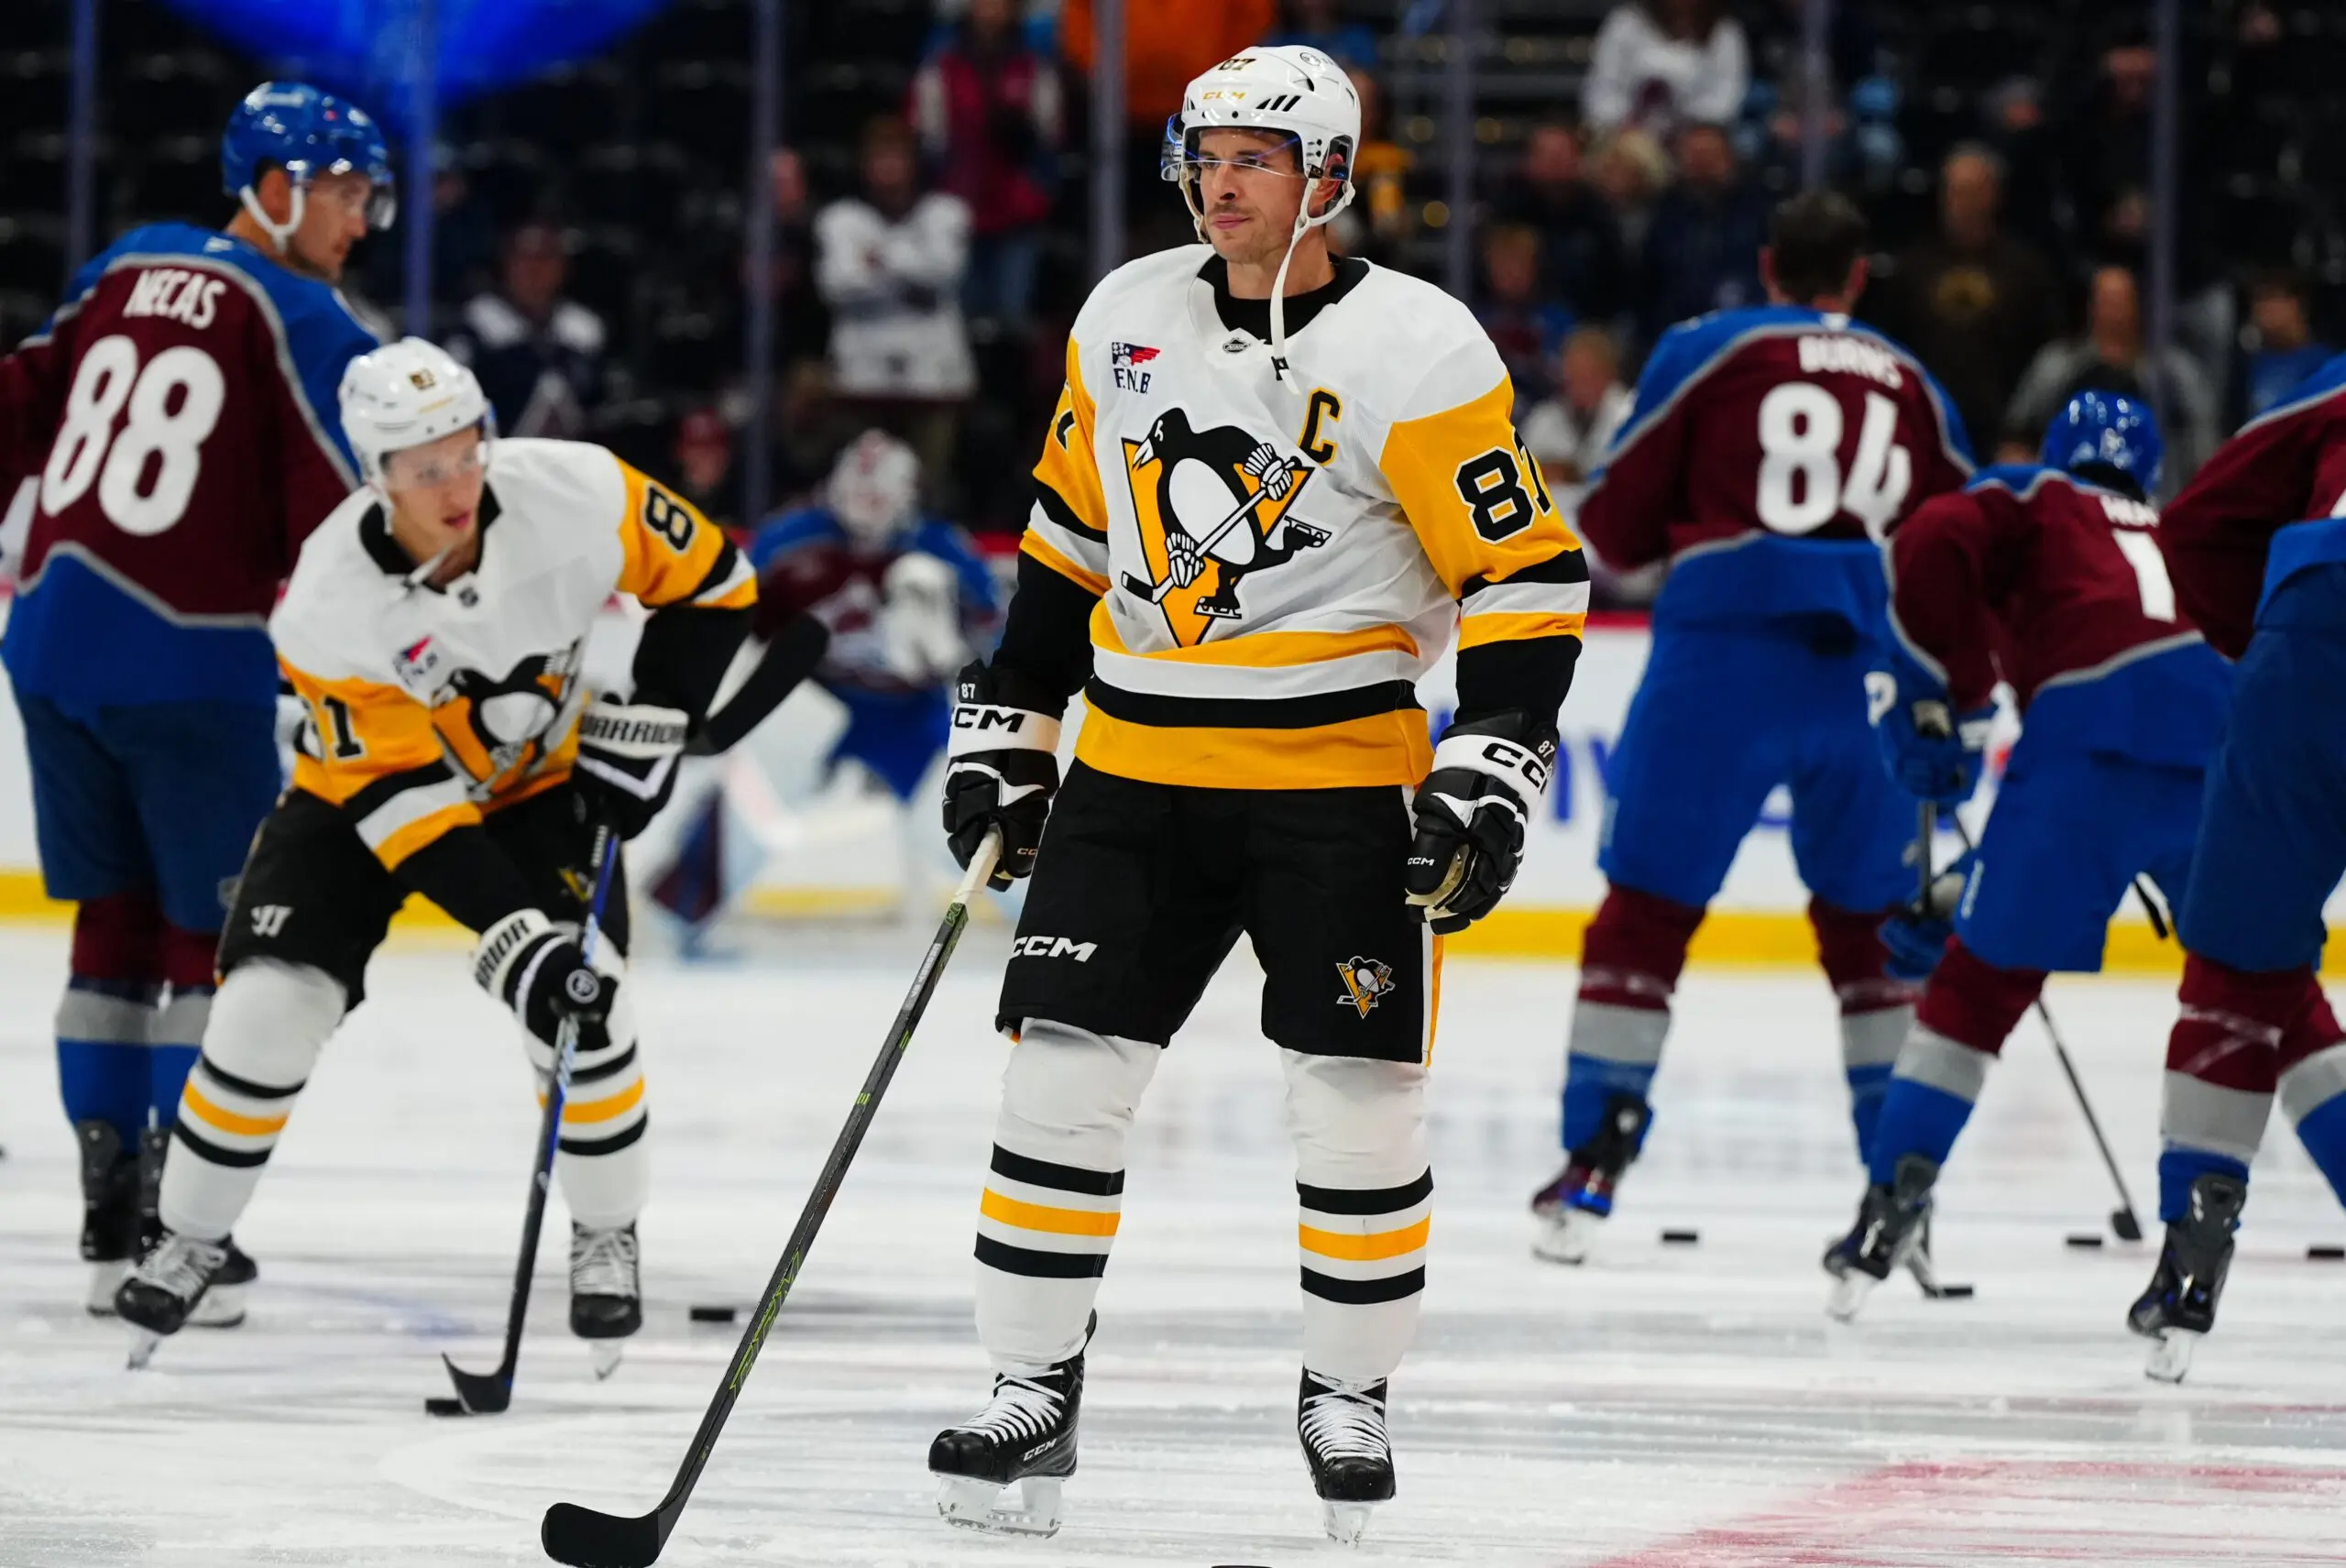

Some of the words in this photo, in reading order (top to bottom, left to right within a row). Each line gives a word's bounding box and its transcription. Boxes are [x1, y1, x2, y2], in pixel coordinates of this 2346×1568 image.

[123, 269, 226, 330] NECAS
[41, 334, 225, 536] 88
[1297, 387, 1343, 466] C
[1756, 380, 1912, 543] 84
[960, 682, 977, 699] 87
[950, 706, 1026, 734] CM
[1537, 739, 1556, 759] 87
[1481, 741, 1549, 796] CC
[1407, 857, 1435, 867] CCM
[1009, 935, 1099, 963] CCM
[1023, 1437, 1058, 1462] CCM
